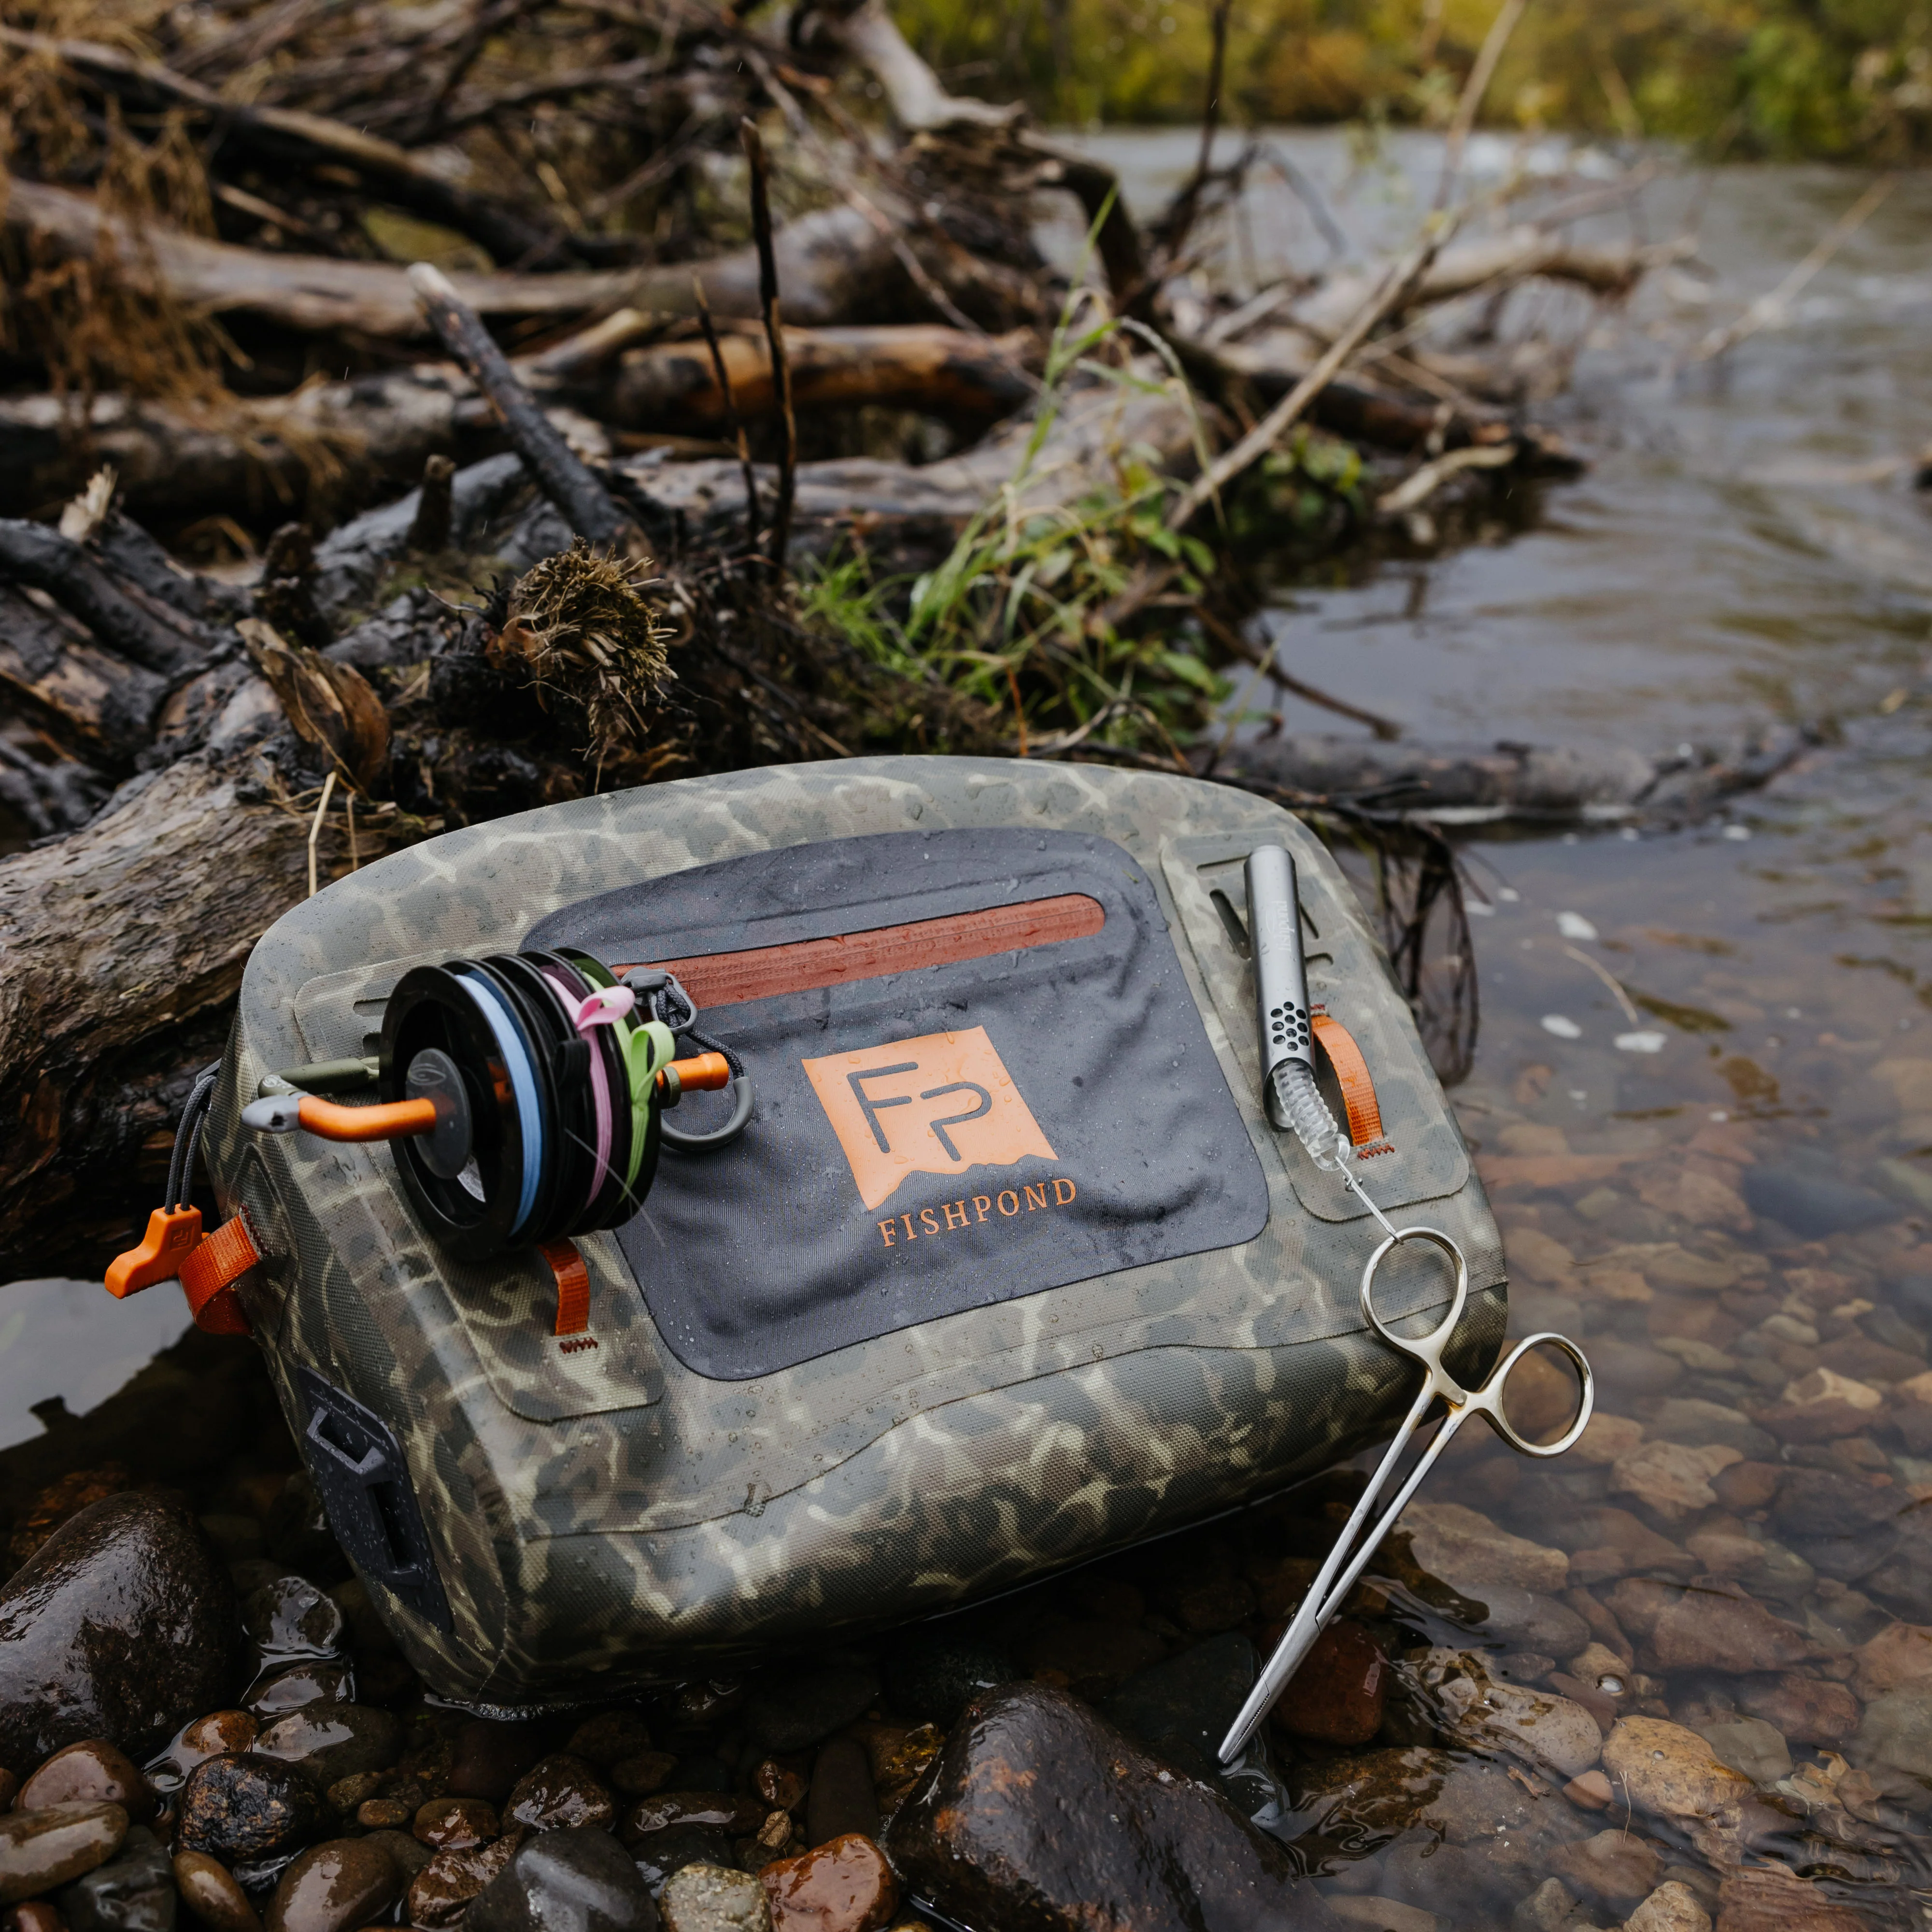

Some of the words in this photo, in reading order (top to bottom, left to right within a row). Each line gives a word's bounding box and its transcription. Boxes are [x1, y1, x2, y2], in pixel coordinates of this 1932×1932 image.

[1271, 900, 1295, 952] fishpond
[846, 1062, 993, 1162] FP
[877, 1179, 1076, 1248] FISHPOND
